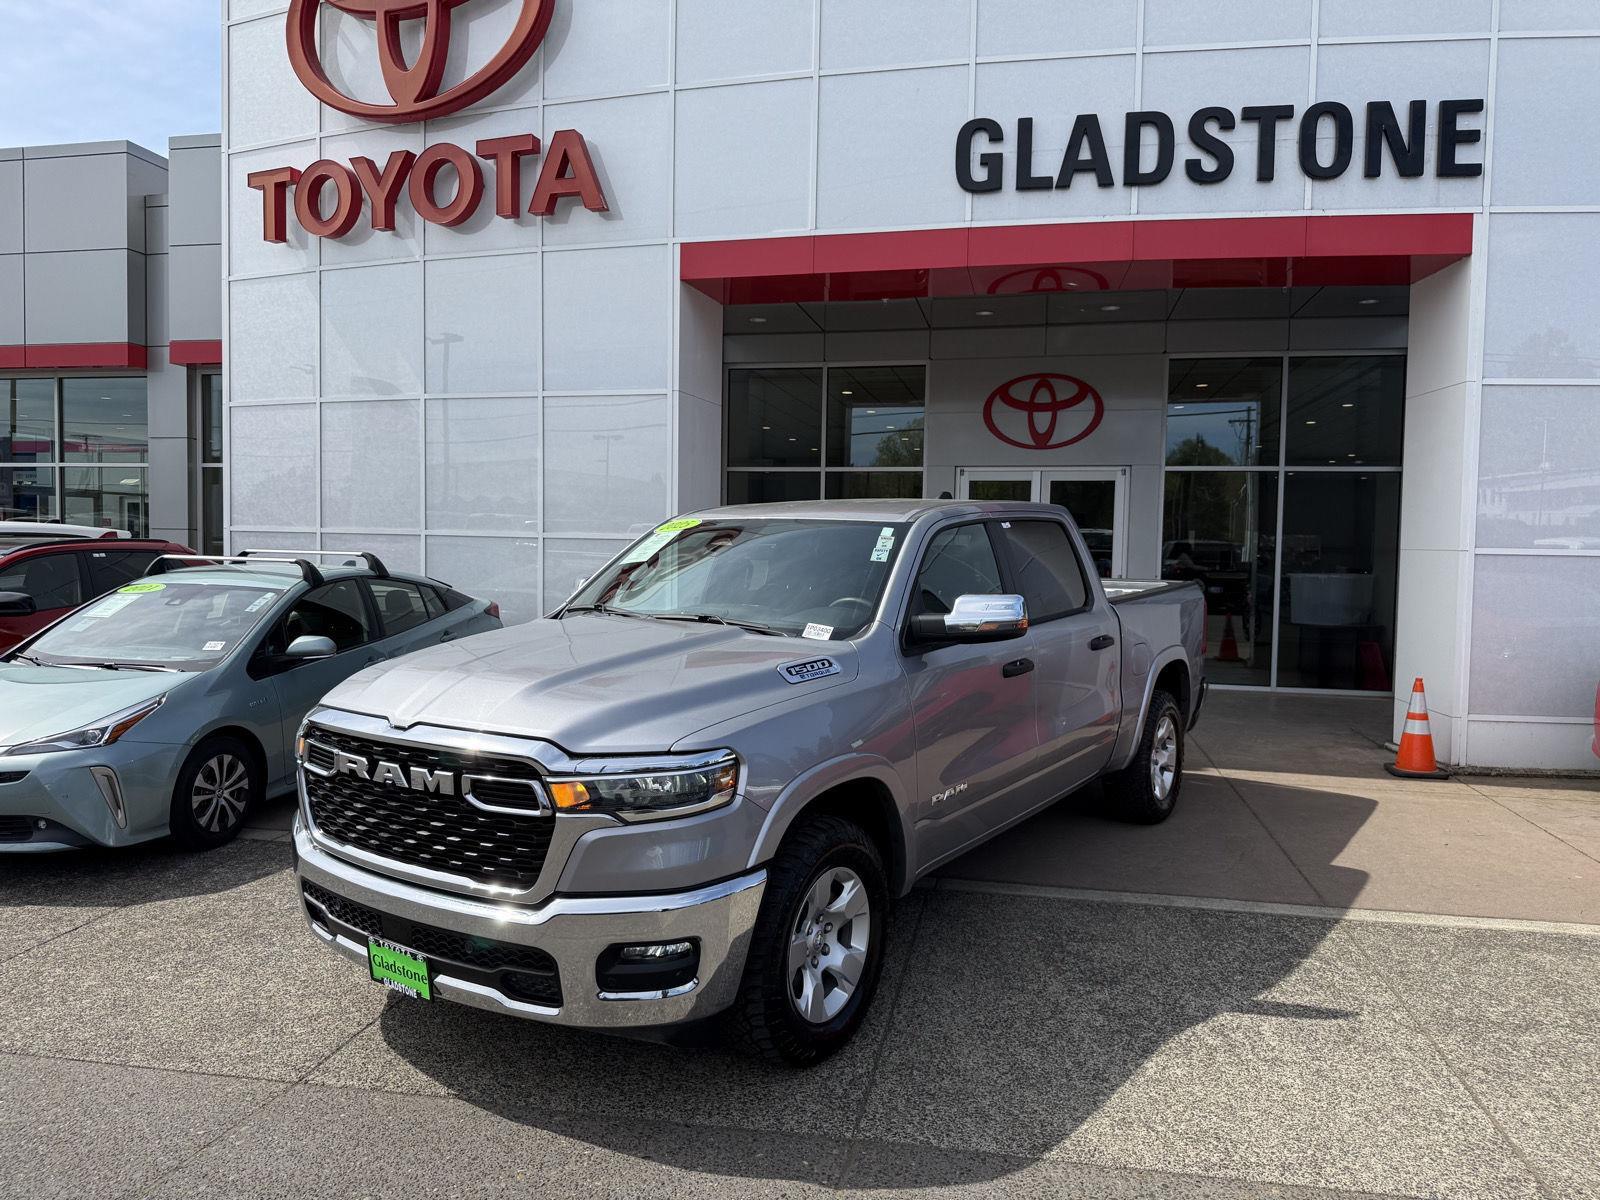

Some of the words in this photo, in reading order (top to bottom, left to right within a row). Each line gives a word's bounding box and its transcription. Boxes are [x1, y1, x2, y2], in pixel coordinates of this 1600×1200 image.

[955, 98, 1485, 193] GLADSTONE
[247, 128, 609, 244] TOYOTA
[787, 659, 830, 676] 1500
[338, 751, 455, 796] RAM
[931, 780, 968, 807] RAM
[372, 953, 428, 985] Gladstone
[383, 977, 418, 999] GLADSTONE
